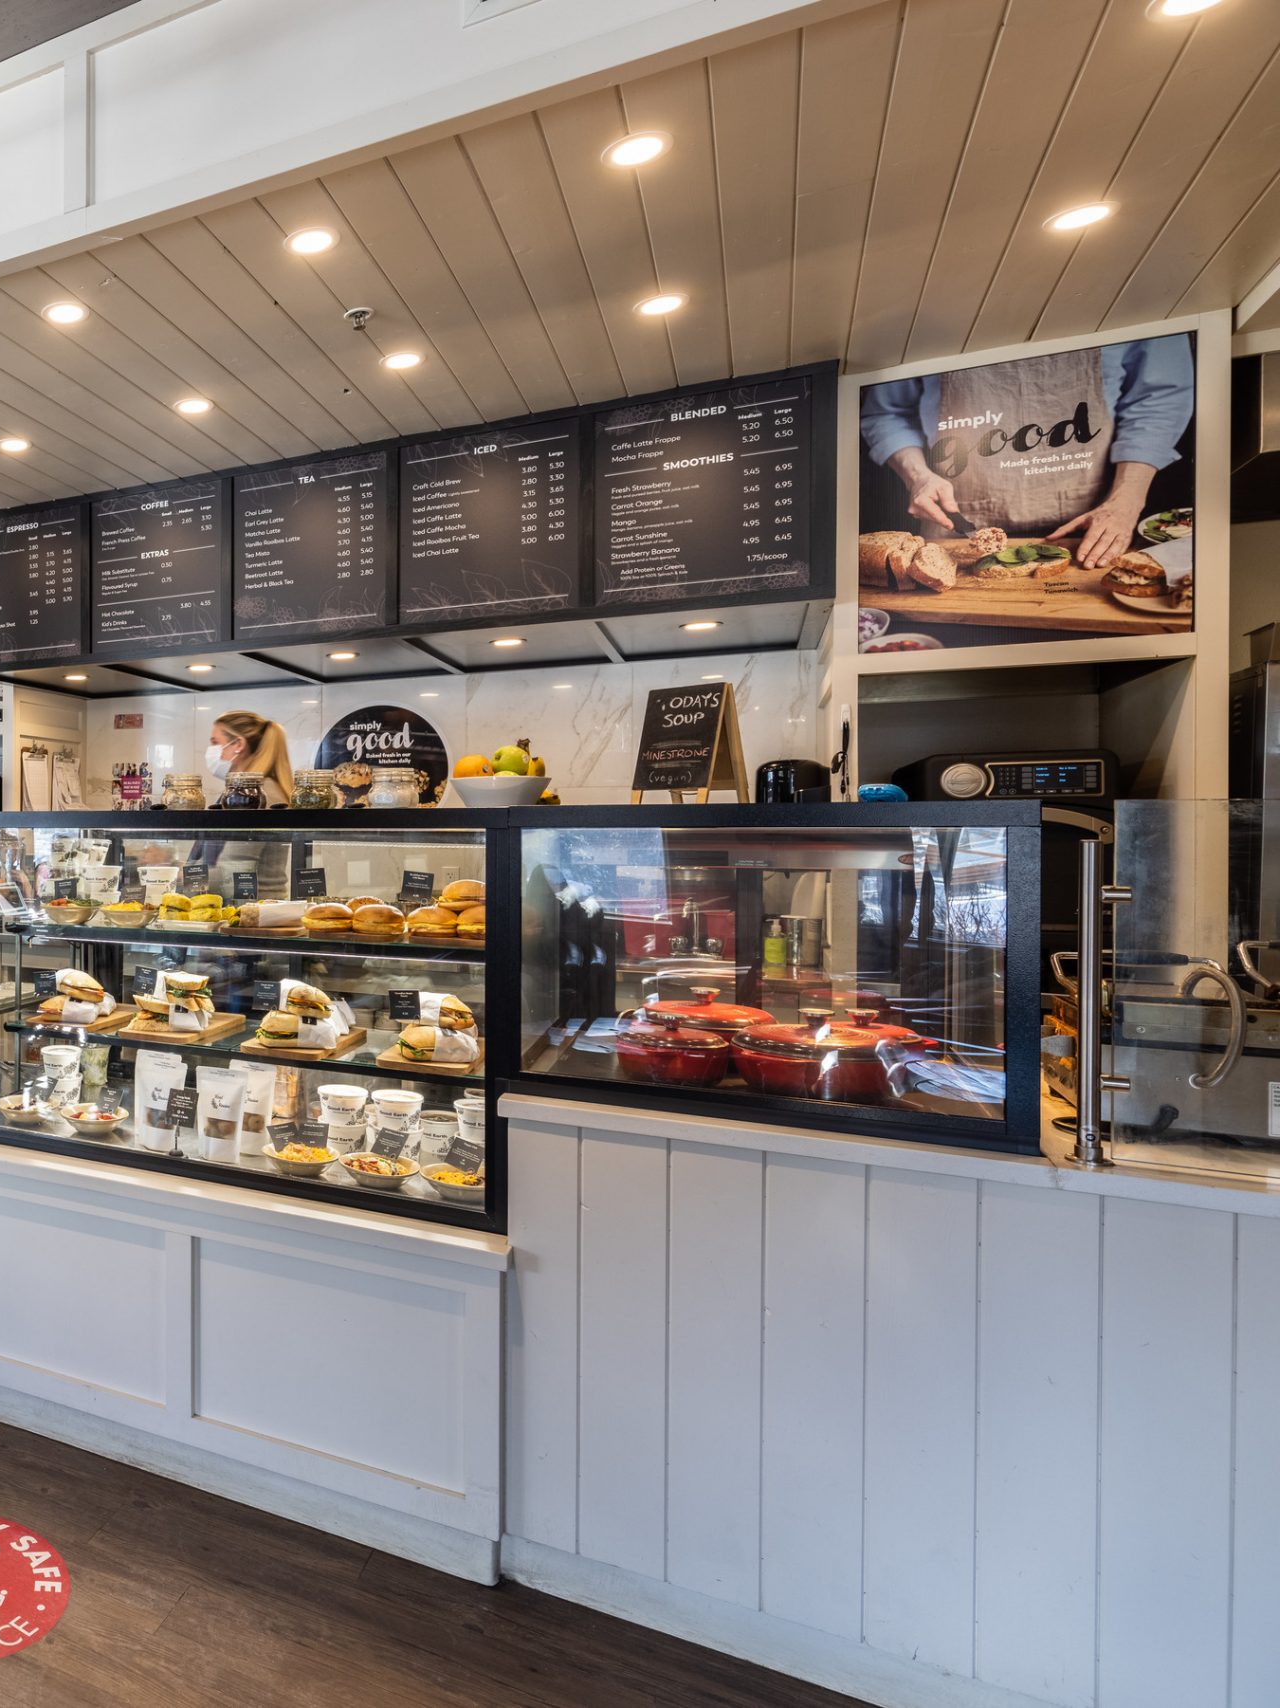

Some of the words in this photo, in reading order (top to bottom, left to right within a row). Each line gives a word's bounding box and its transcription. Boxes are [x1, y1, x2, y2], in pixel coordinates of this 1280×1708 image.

[671, 405, 726, 422] BLENDED
[738, 412, 762, 420] Medium
[938, 410, 1004, 431] simply
[611, 442, 632, 451] Caffe
[633, 440, 653, 448] Latte
[654, 435, 681, 445] Frappe
[742, 422, 760, 431] 5.20
[774, 417, 793, 426] 6.50
[930, 401, 1102, 478] good
[474, 444, 497, 455] ICED
[612, 454, 636, 463] Mocha
[637, 450, 664, 461] Frappe
[742, 434, 760, 443] 5.20
[774, 429, 793, 438] 6.50
[663, 453, 734, 471] SMOOTHIES
[1000, 459, 1030, 469] Made
[1030, 454, 1060, 464] fresh
[1061, 453, 1073, 461] in
[1074, 451, 1094, 459] our
[1024, 465, 1065, 476] kitchen
[1067, 461, 1093, 471] daily
[298, 475, 315, 484] TEA
[611, 486, 631, 494] Fresh
[632, 480, 671, 492] Strawberry
[743, 467, 760, 476] 5.45
[775, 463, 792, 472] 6.95
[426, 492, 447, 500] Coffee
[611, 503, 634, 511] Carrot
[635, 499, 663, 511] Orange
[743, 485, 760, 493] 5.45
[775, 480, 792, 489] 6.95
[141, 500, 169, 511] COFFEE
[426, 501, 460, 511] Americano
[611, 519, 637, 527] Mango
[743, 502, 760, 510] 5.45
[775, 498, 792, 506] 6.95
[6, 522, 39, 533] ESPRESSO
[426, 515, 443, 523] Caffe
[426, 526, 443, 534] Caffe
[444, 523, 466, 531] Mocha
[521, 513, 537, 521] 5.00
[548, 509, 565, 517] 6.00
[611, 535, 634, 544] Carrot
[635, 530, 668, 541] Sunshine
[743, 519, 760, 527] 4.95
[775, 515, 792, 524] 6.45
[426, 537, 451, 545] Rooibos
[611, 550, 649, 561] Strawberry
[651, 547, 680, 555] Banana
[743, 537, 760, 545] 4.95
[774, 532, 792, 541] 6.45
[141, 549, 169, 559] EXTRAS
[664, 563, 685, 571] Greens
[747, 552, 788, 562] 1.75/scoop
[349, 721, 382, 732] simply
[662, 712, 705, 728] SOUP
[346, 722, 414, 761] good
[641, 747, 710, 760] MINESTRONE
[649, 770, 692, 784] (vegan)
[10, 1535, 62, 1593] SAFE
